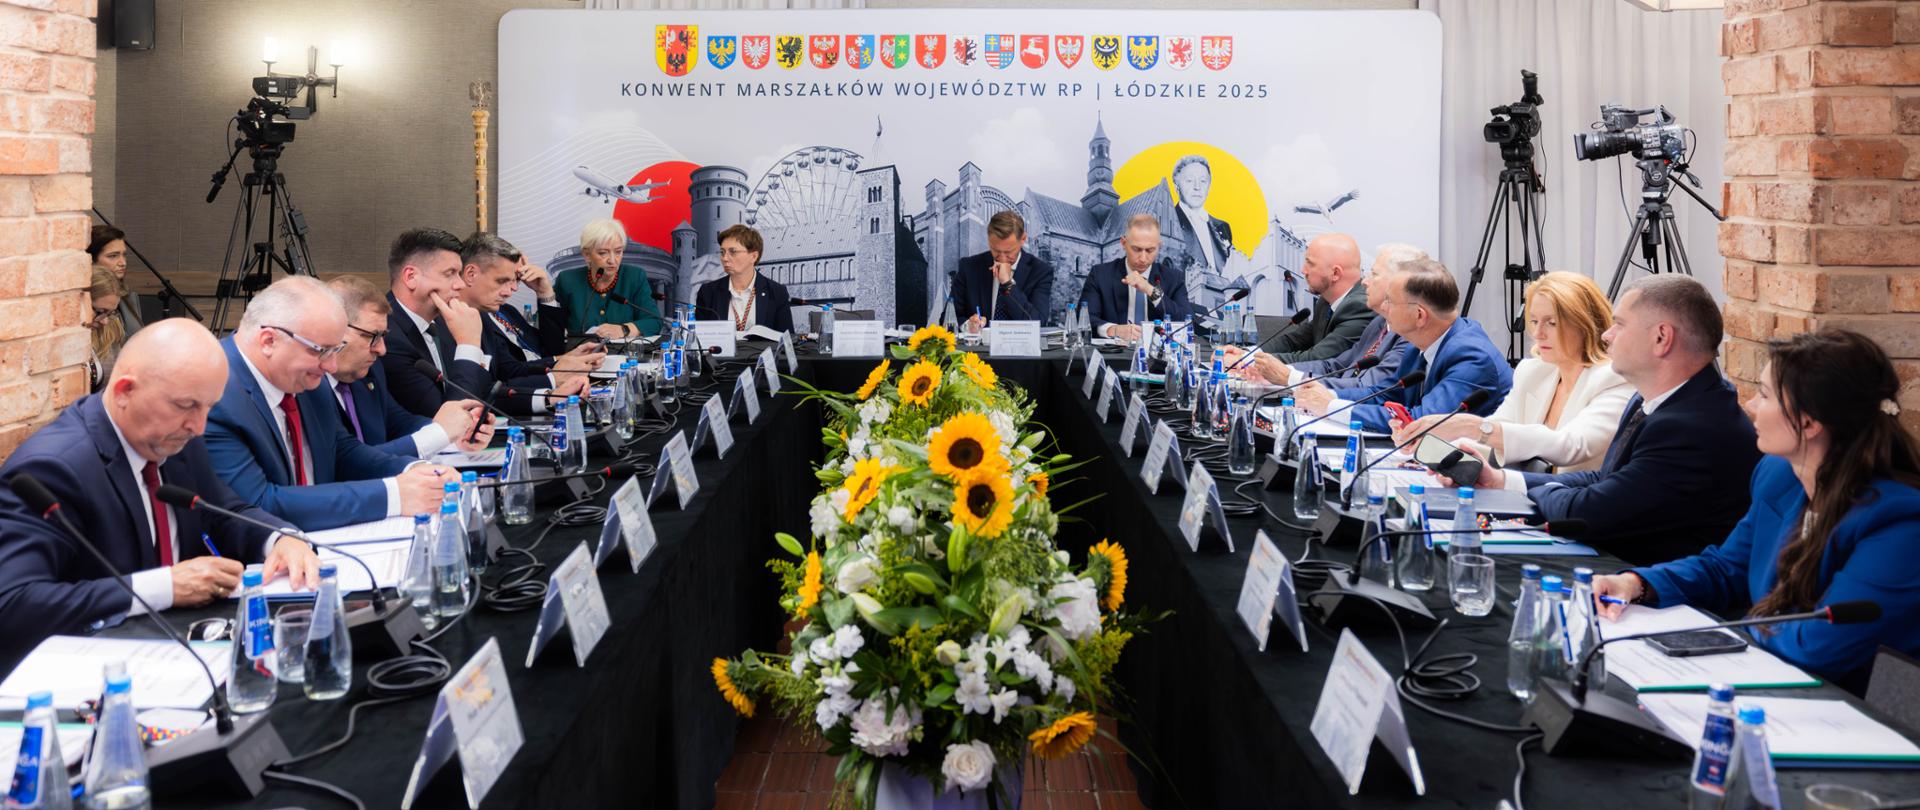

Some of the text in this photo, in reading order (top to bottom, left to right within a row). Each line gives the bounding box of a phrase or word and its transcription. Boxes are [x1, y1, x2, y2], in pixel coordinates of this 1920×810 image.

[621, 82, 727, 97] KONWENT
[736, 79, 884, 97] MARSZAŁKÓW
[894, 79, 1047, 99] WOJEWÓDZTW
[1058, 83, 1083, 97] RP
[1114, 80, 1207, 98] ŁÓDZKIE
[1217, 84, 1268, 98] 2025
